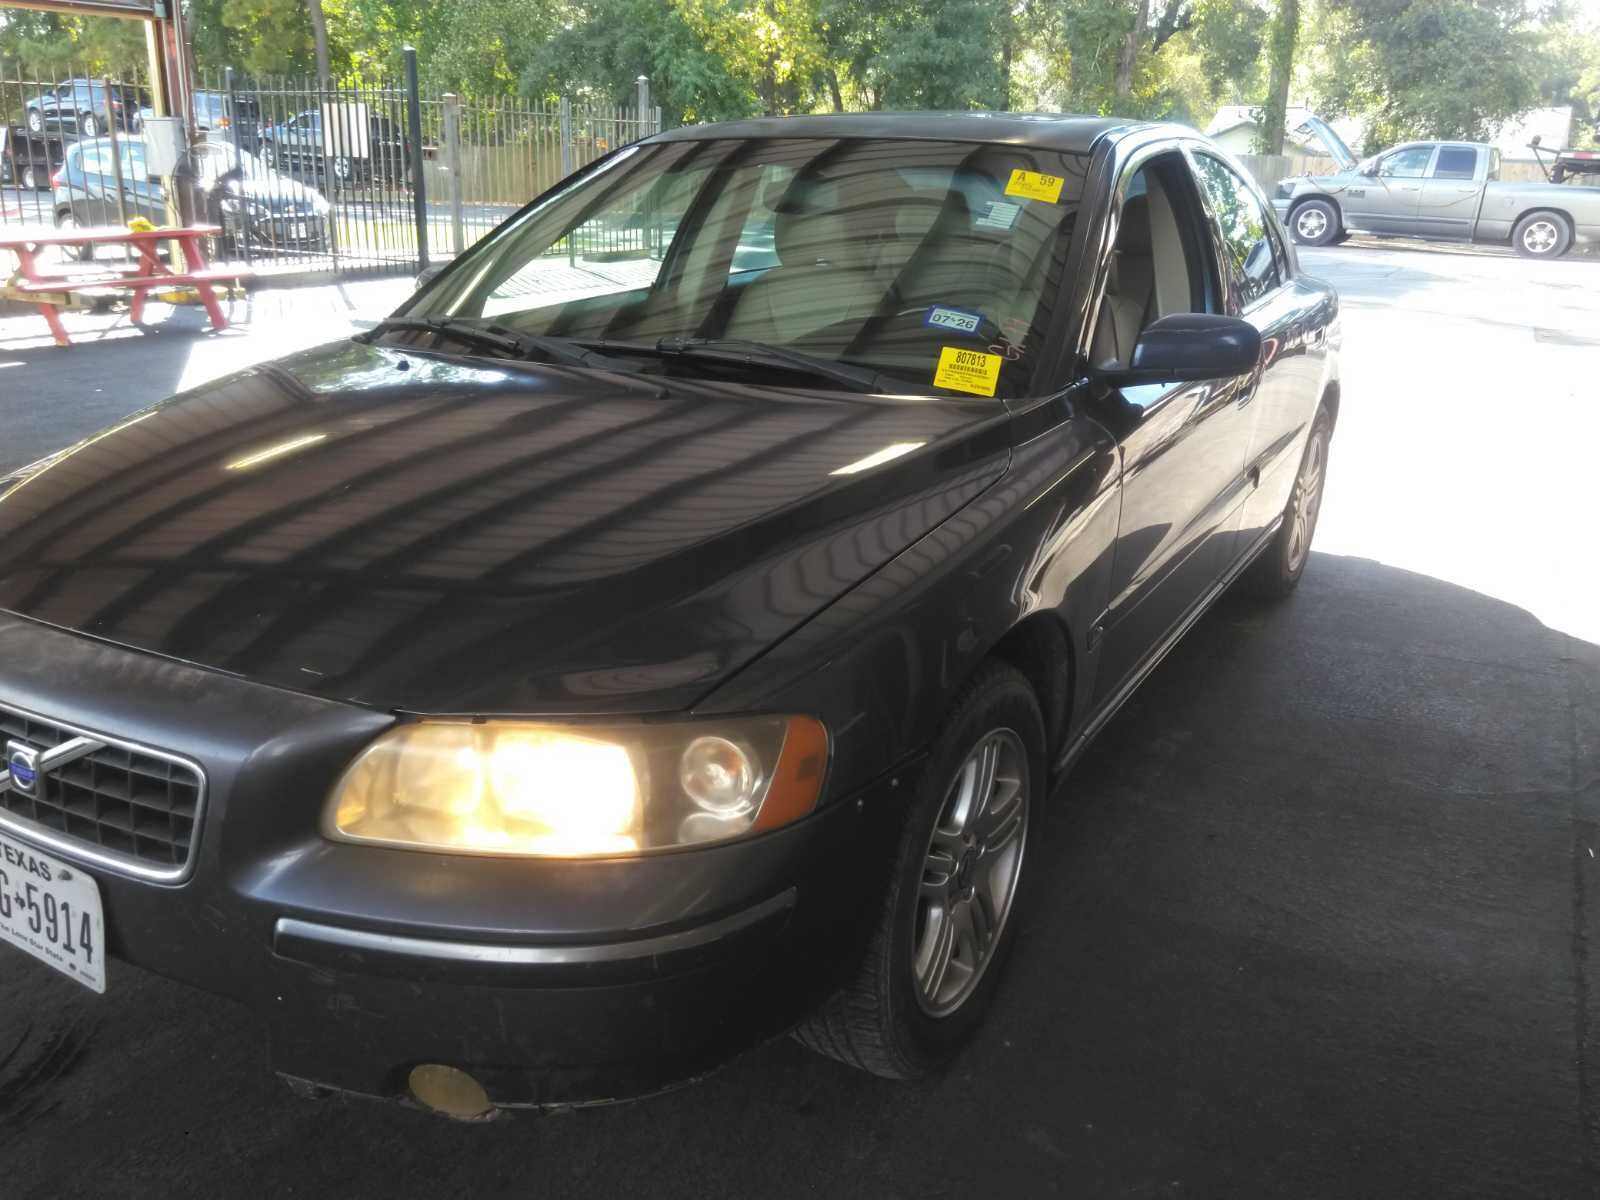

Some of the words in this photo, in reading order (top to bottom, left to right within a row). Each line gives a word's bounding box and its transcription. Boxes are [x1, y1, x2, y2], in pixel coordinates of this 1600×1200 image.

[1016, 172, 1025, 184] A
[1040, 175, 1055, 187] 59
[956, 352, 986, 367] 807813
